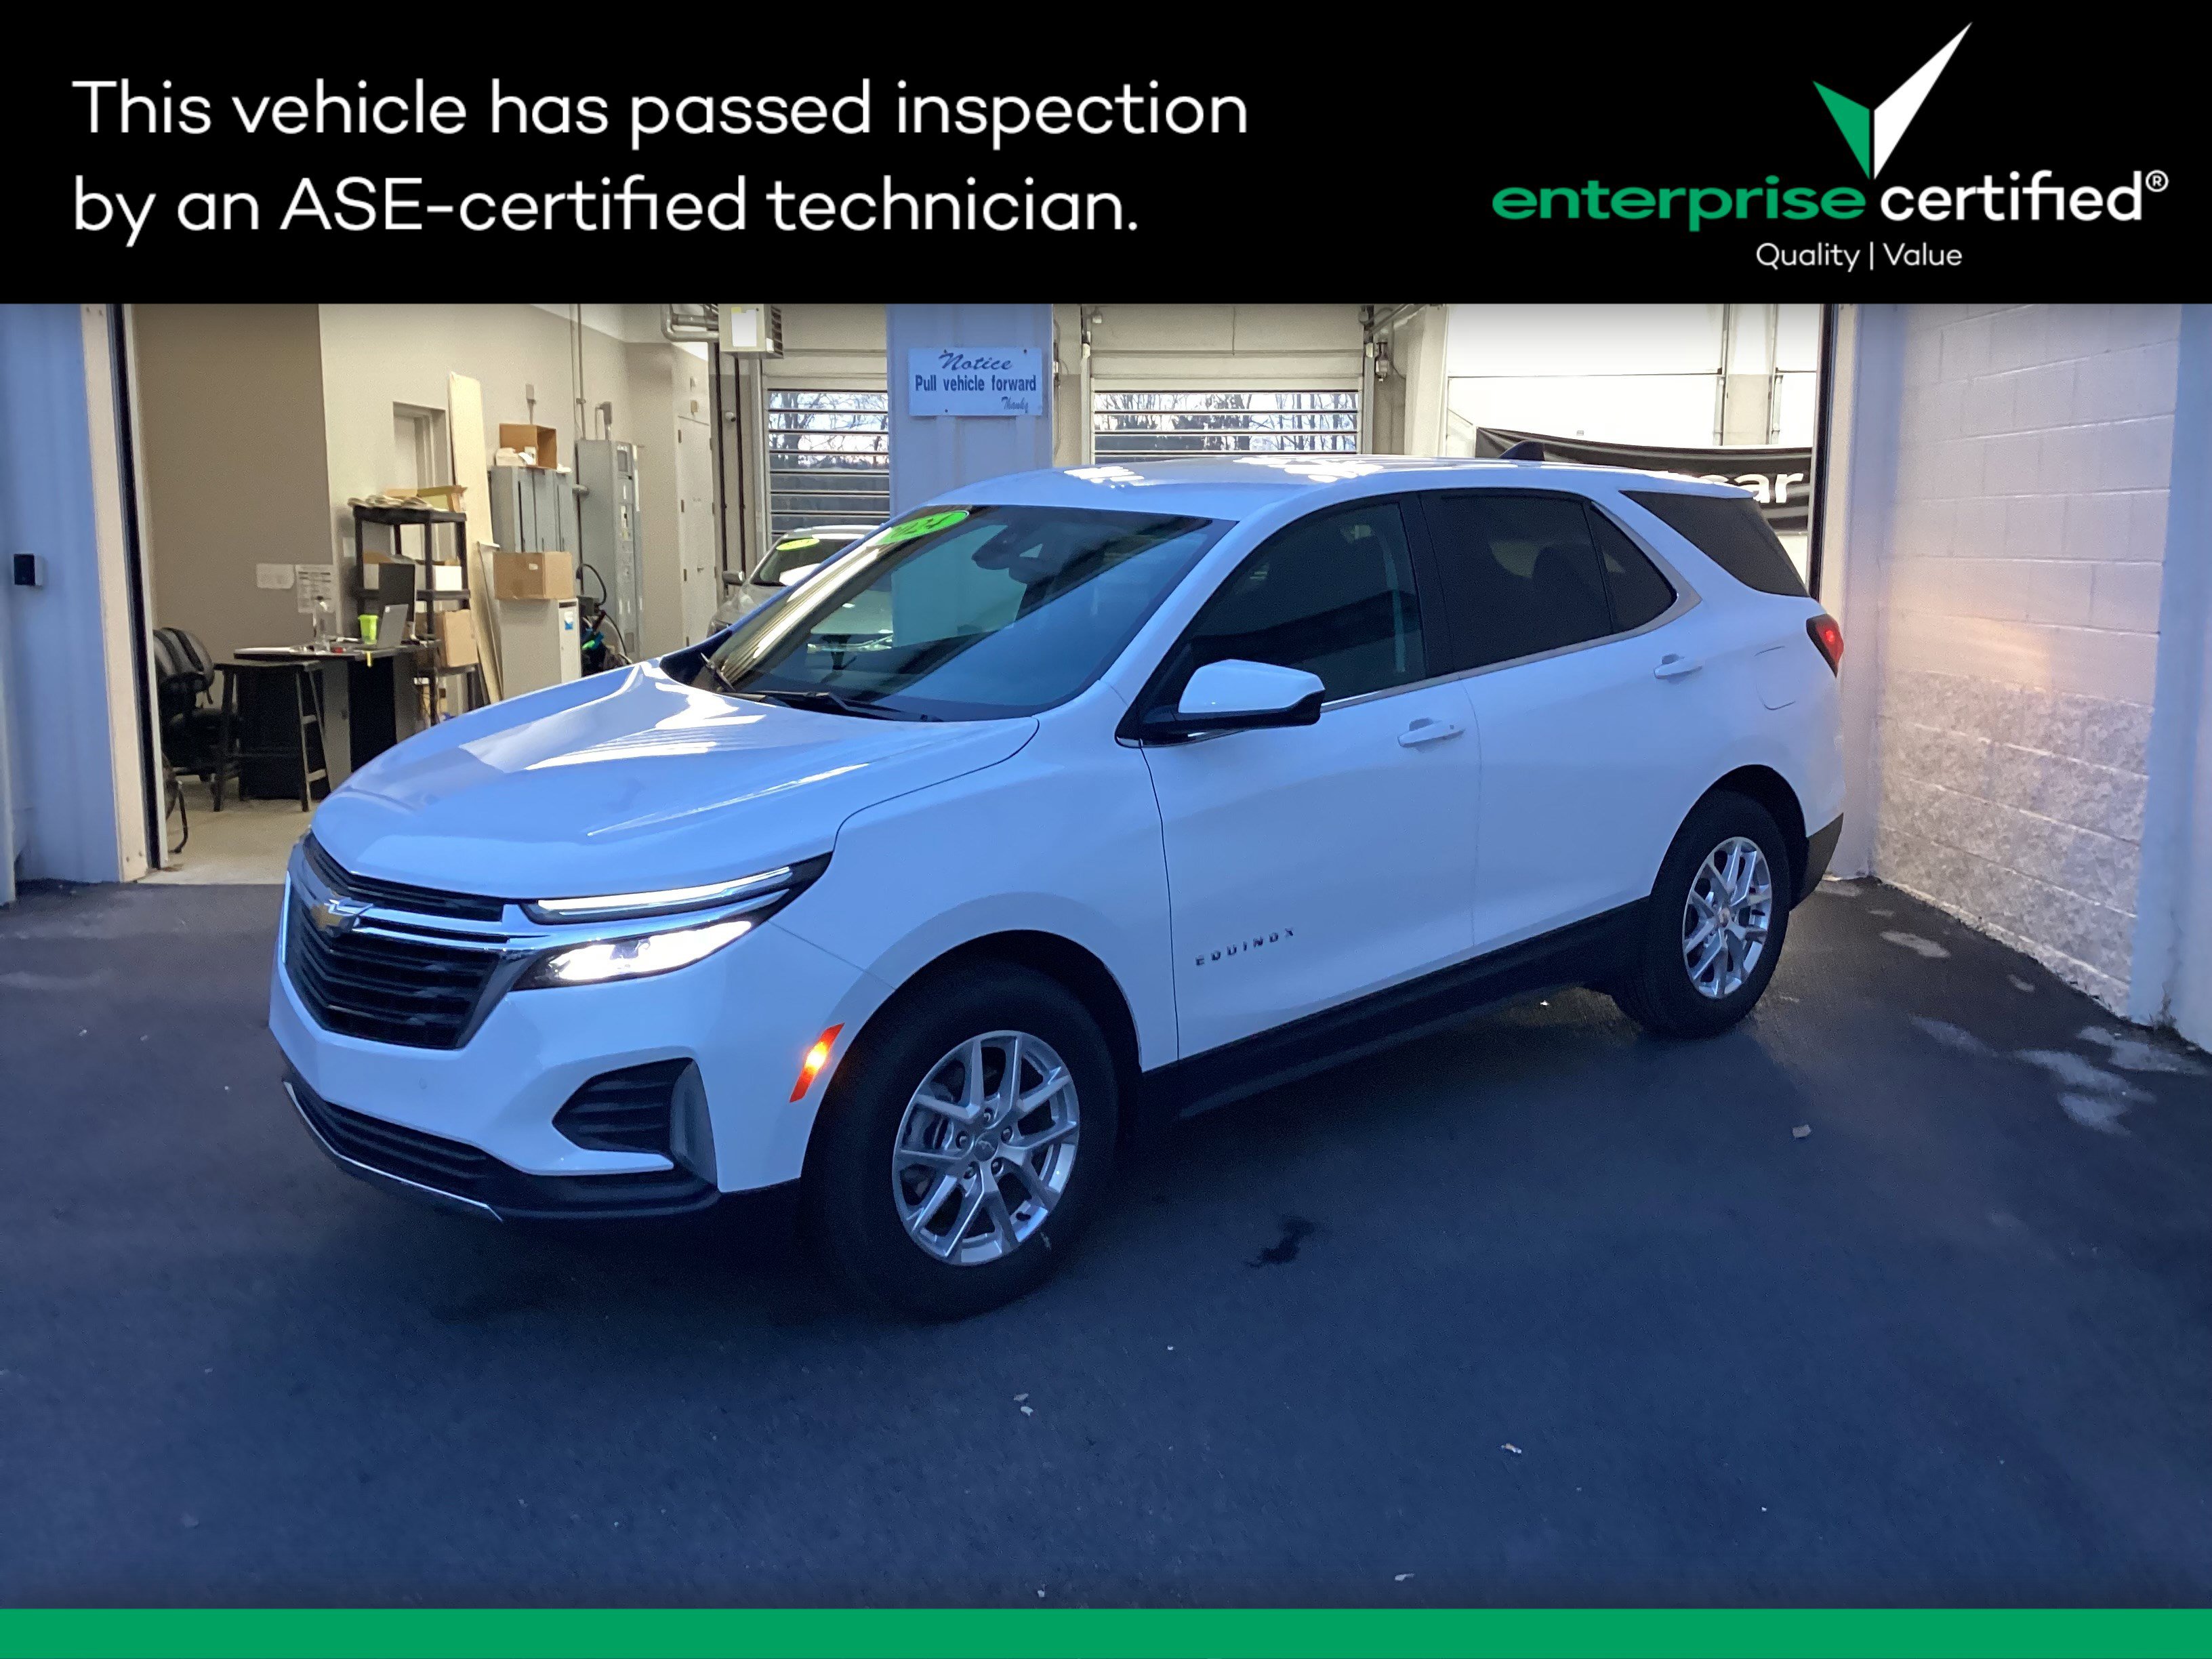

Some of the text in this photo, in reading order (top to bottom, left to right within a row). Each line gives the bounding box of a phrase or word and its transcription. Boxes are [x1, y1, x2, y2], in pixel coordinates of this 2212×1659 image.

[939, 352, 1013, 371] Notice
[916, 374, 1037, 391] Pull vehicle forward
[1195, 927, 1294, 966] EQUINOX
